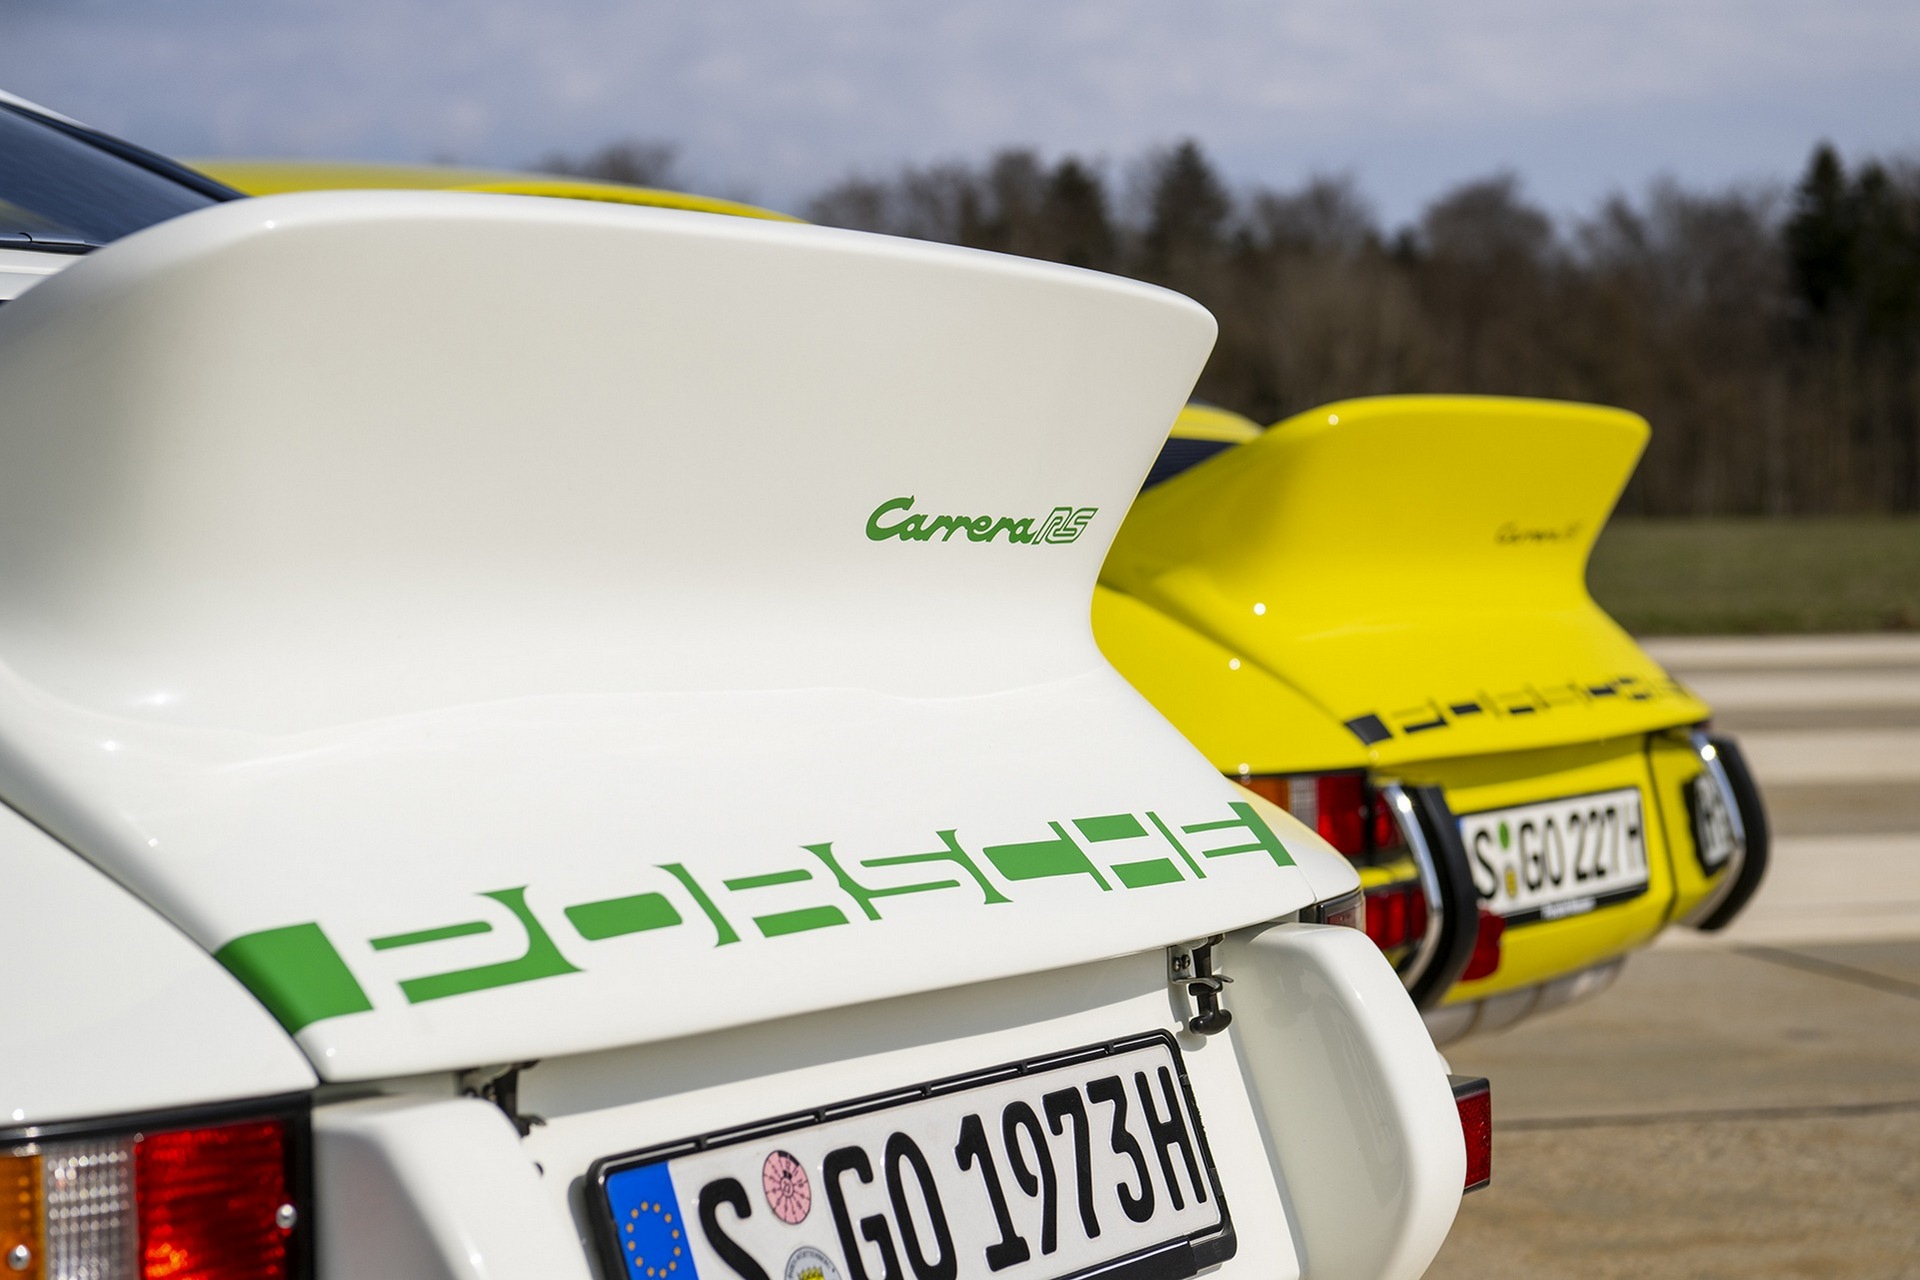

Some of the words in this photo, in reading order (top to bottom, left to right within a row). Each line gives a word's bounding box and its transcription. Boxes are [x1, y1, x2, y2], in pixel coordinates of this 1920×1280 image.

[270, 803, 1294, 1025] PORSCHE
[1474, 829, 1498, 900] S
[698, 1177, 770, 1280] S
[823, 1131, 958, 1280] GO
[954, 1065, 1207, 1273] 1973H
